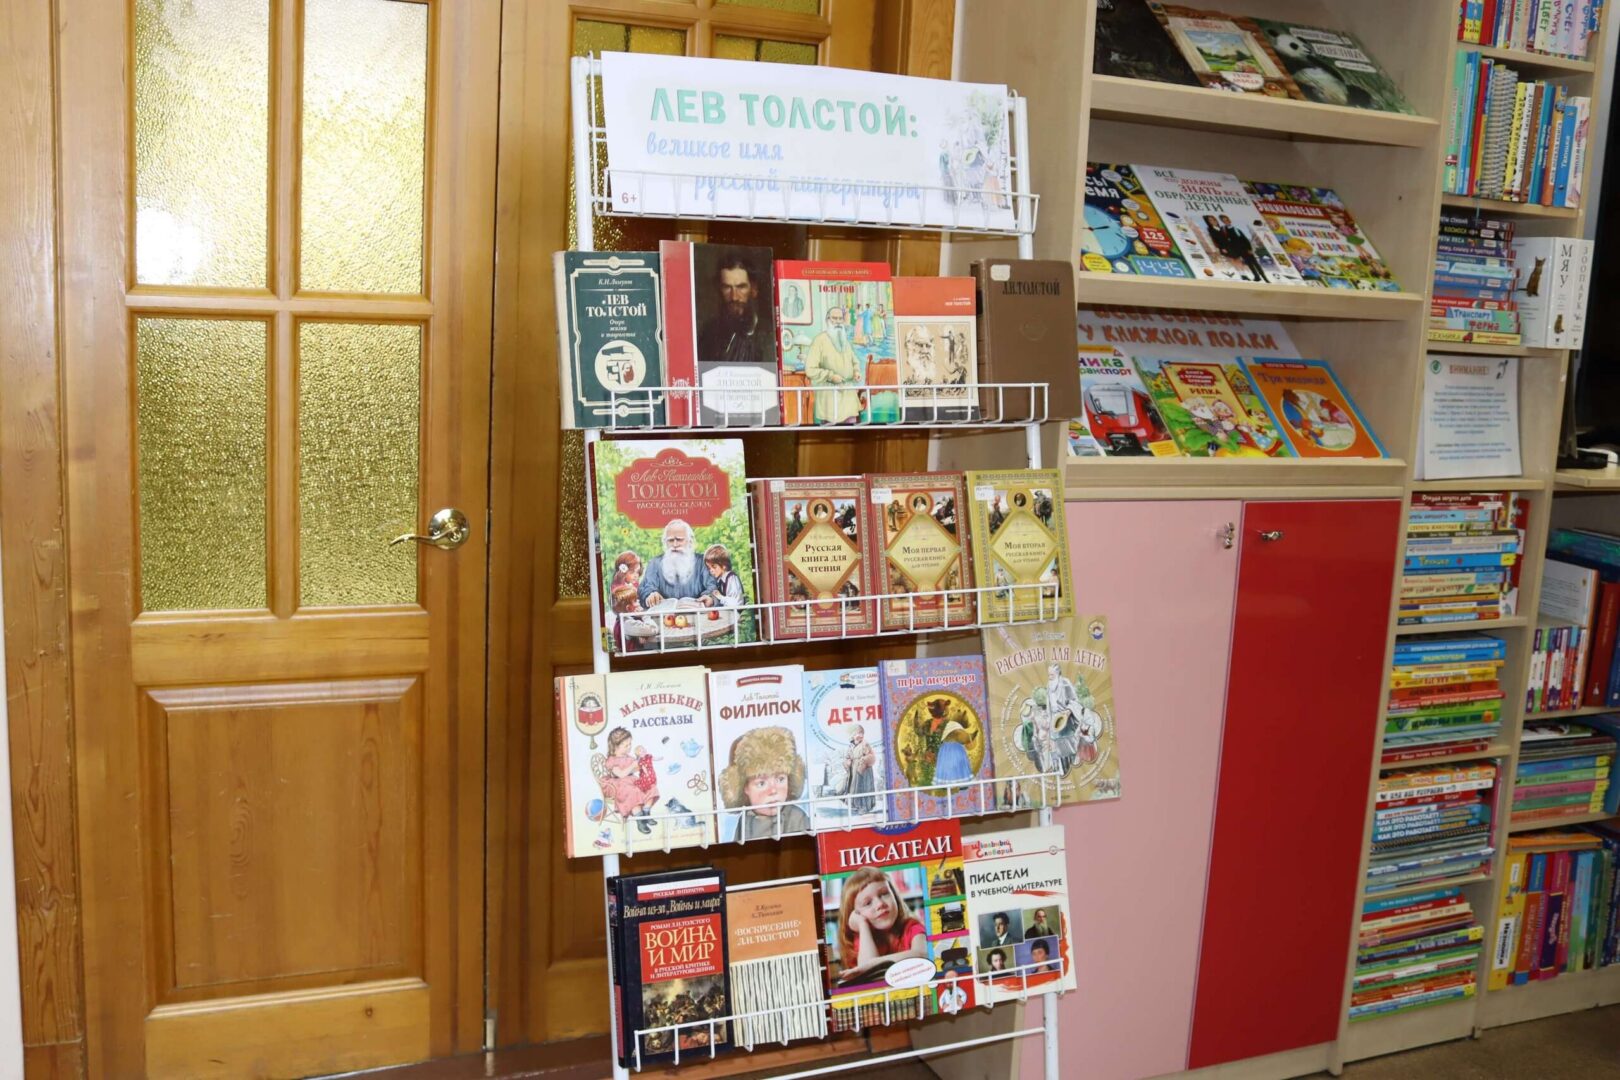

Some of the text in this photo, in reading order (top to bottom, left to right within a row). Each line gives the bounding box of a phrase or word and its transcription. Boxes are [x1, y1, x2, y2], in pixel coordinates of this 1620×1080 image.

[650, 87, 919, 138] ЛЕВ ТОЛСТОЙ:
[646, 131, 784, 161] великое имя
[621, 192, 637, 205] 6+
[1143, 231, 1166, 240] 125
[601, 294, 630, 305] ЛЕВ
[585, 302, 648, 317] ТОЛСТОЙ
[1102, 324, 1203, 347] КНИЖНОЙ
[1206, 330, 1280, 350] ПОЛКИ
[627, 483, 719, 499] ТОЛСТОЙ
[804, 544, 842, 555] Русская
[831, 555, 847, 563] для
[807, 565, 842, 573] чтения
[996, 647, 1046, 675] РАССКАЗЫ
[1051, 647, 1070, 661] ДЛЯ
[895, 673, 977, 689] три медведя
[619, 693, 704, 718] МАЛЕНЬКИЕ
[719, 699, 802, 720] ФИЛИПОК
[632, 714, 693, 729] РАССКАЗЫ
[839, 835, 953, 868] ПИСАТЕЛИ
[969, 867, 1029, 885] ПИСАТЕЛИ
[970, 878, 1062, 898] В УЧЕБНОЙ ЛИТЕРАТУРЕ
[644, 924, 717, 950] ВОЙНА
[648, 942, 715, 967] И МИР
[685, 961, 710, 970] КРИТИКЕ
